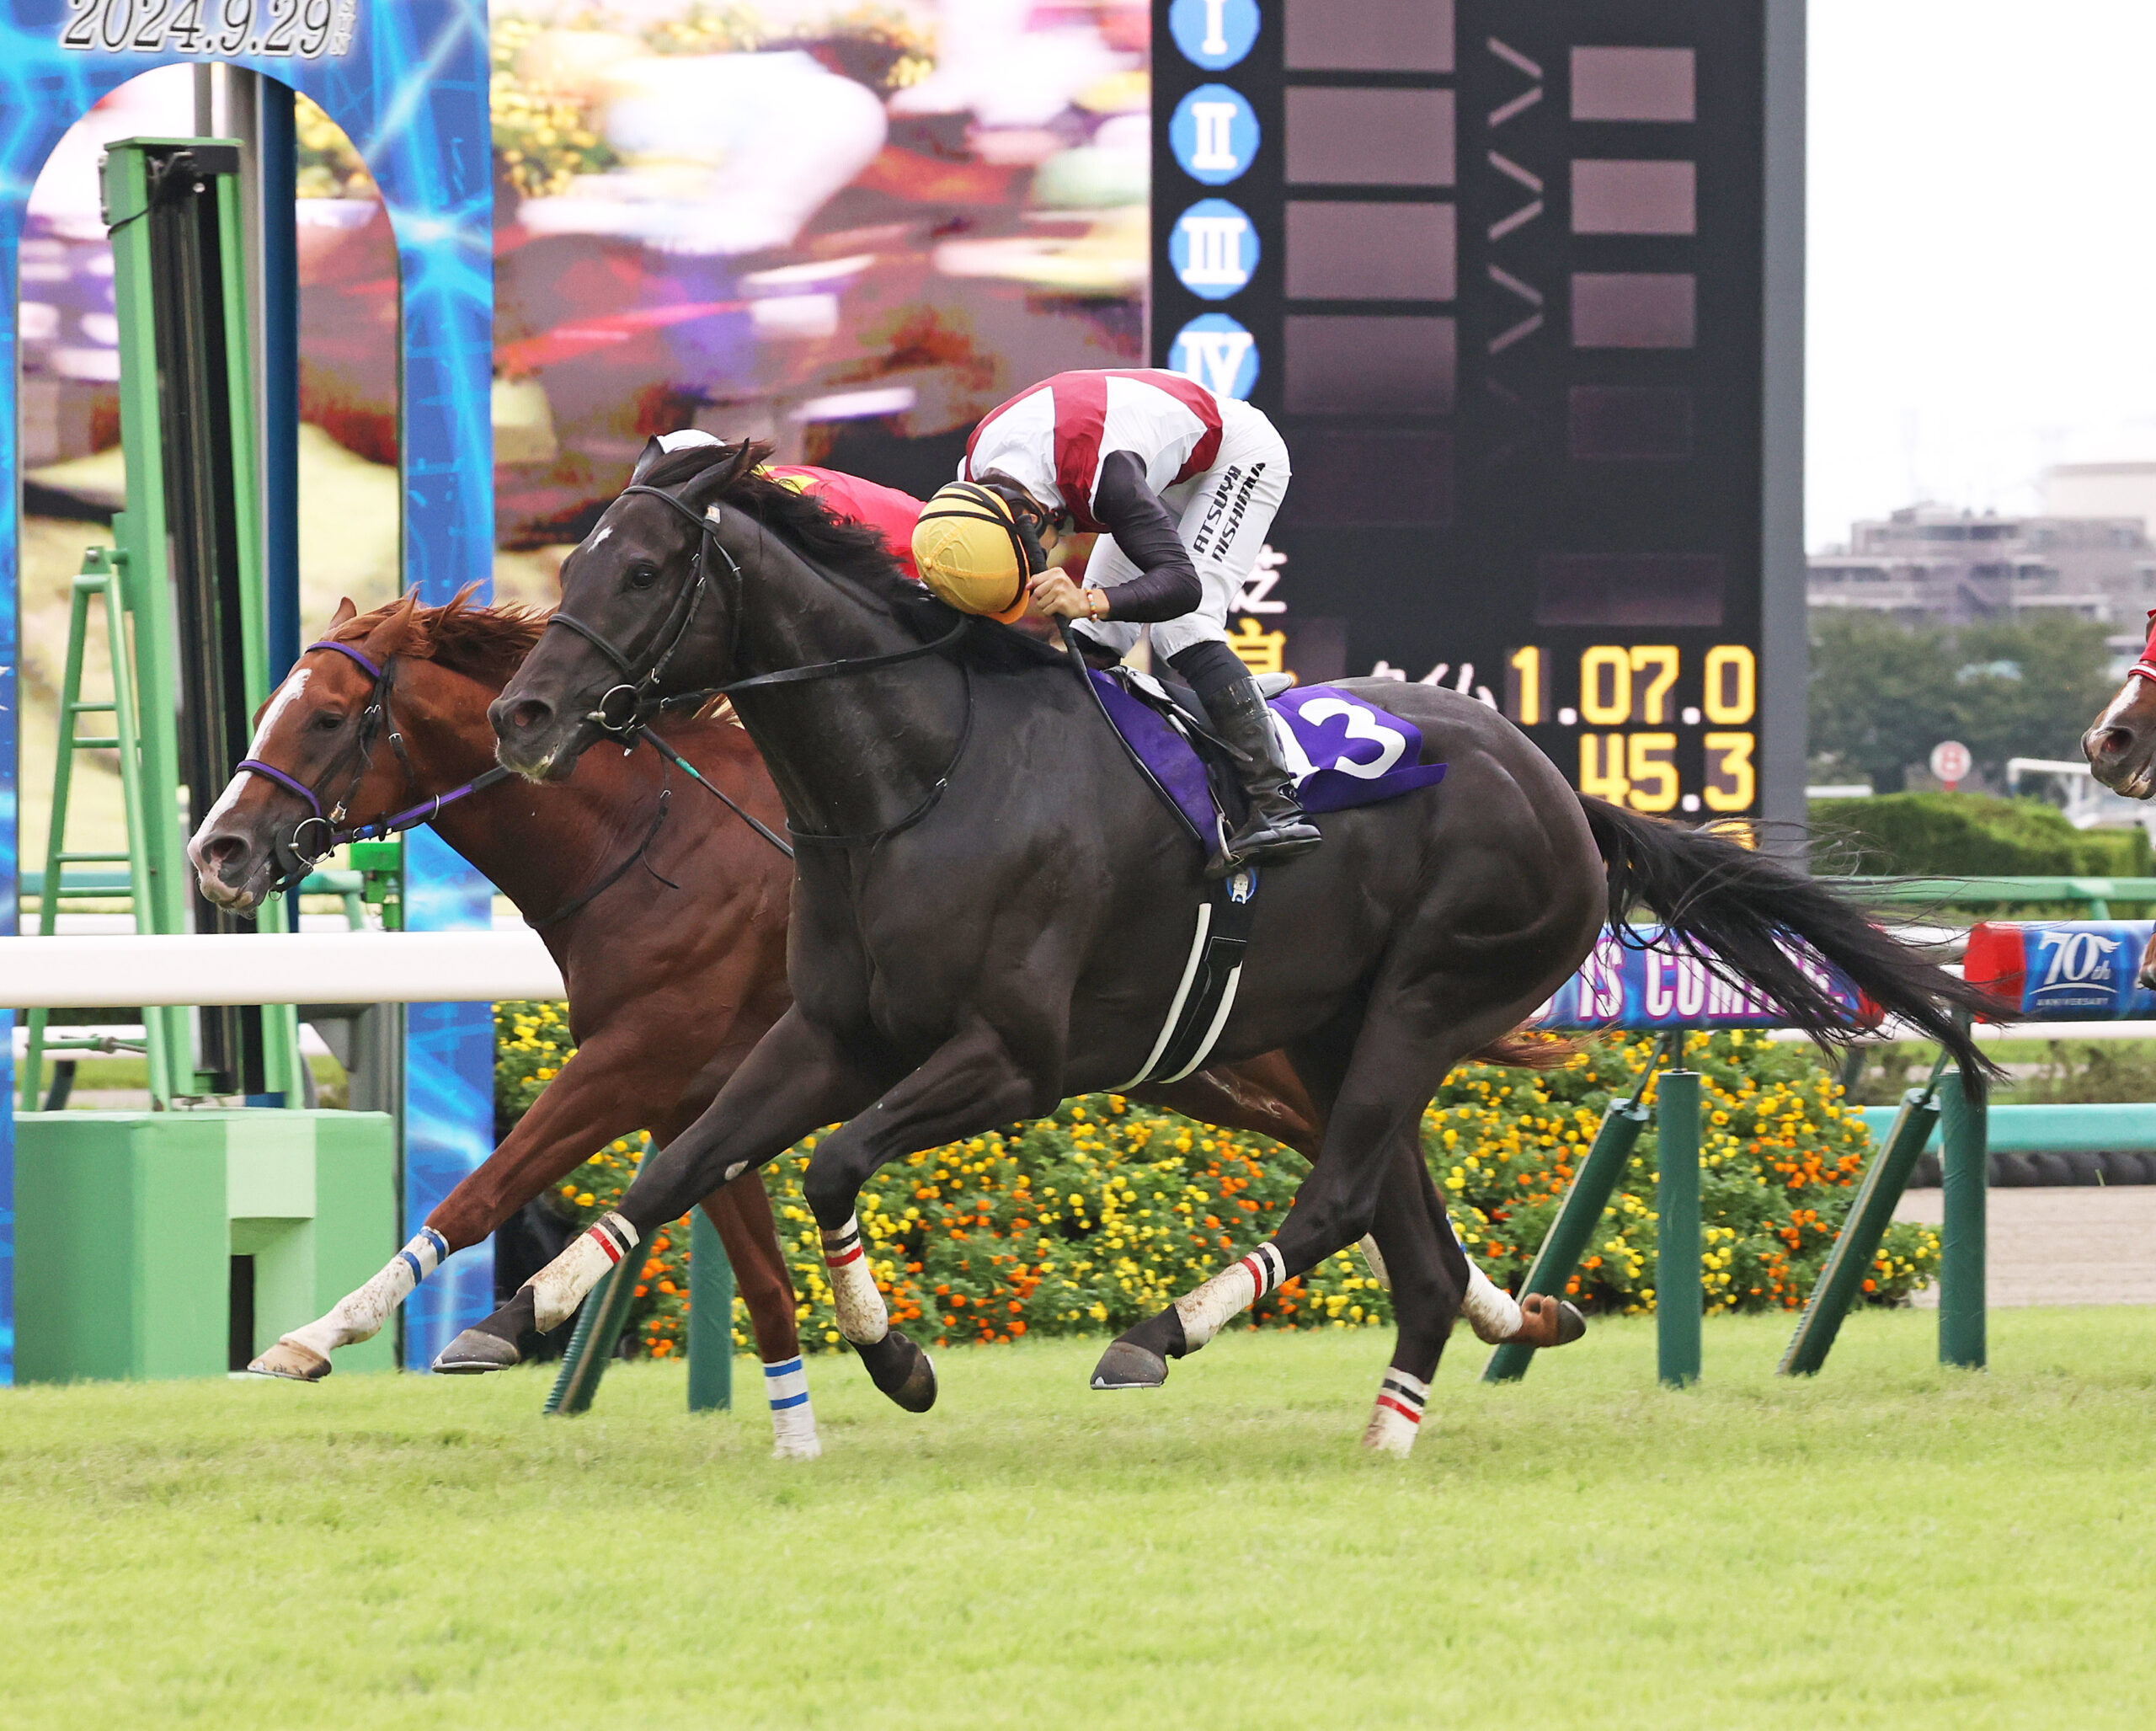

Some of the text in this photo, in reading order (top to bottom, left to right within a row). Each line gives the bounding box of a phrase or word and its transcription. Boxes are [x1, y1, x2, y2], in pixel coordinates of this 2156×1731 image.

[62, 0, 331, 56] 2024.9.29
[1193, 465, 1242, 554] ATSUYA
[1512, 645, 1756, 725] 1.07.0
[1580, 732, 1755, 811] 45.3
[1579, 938, 1624, 1018] IS
